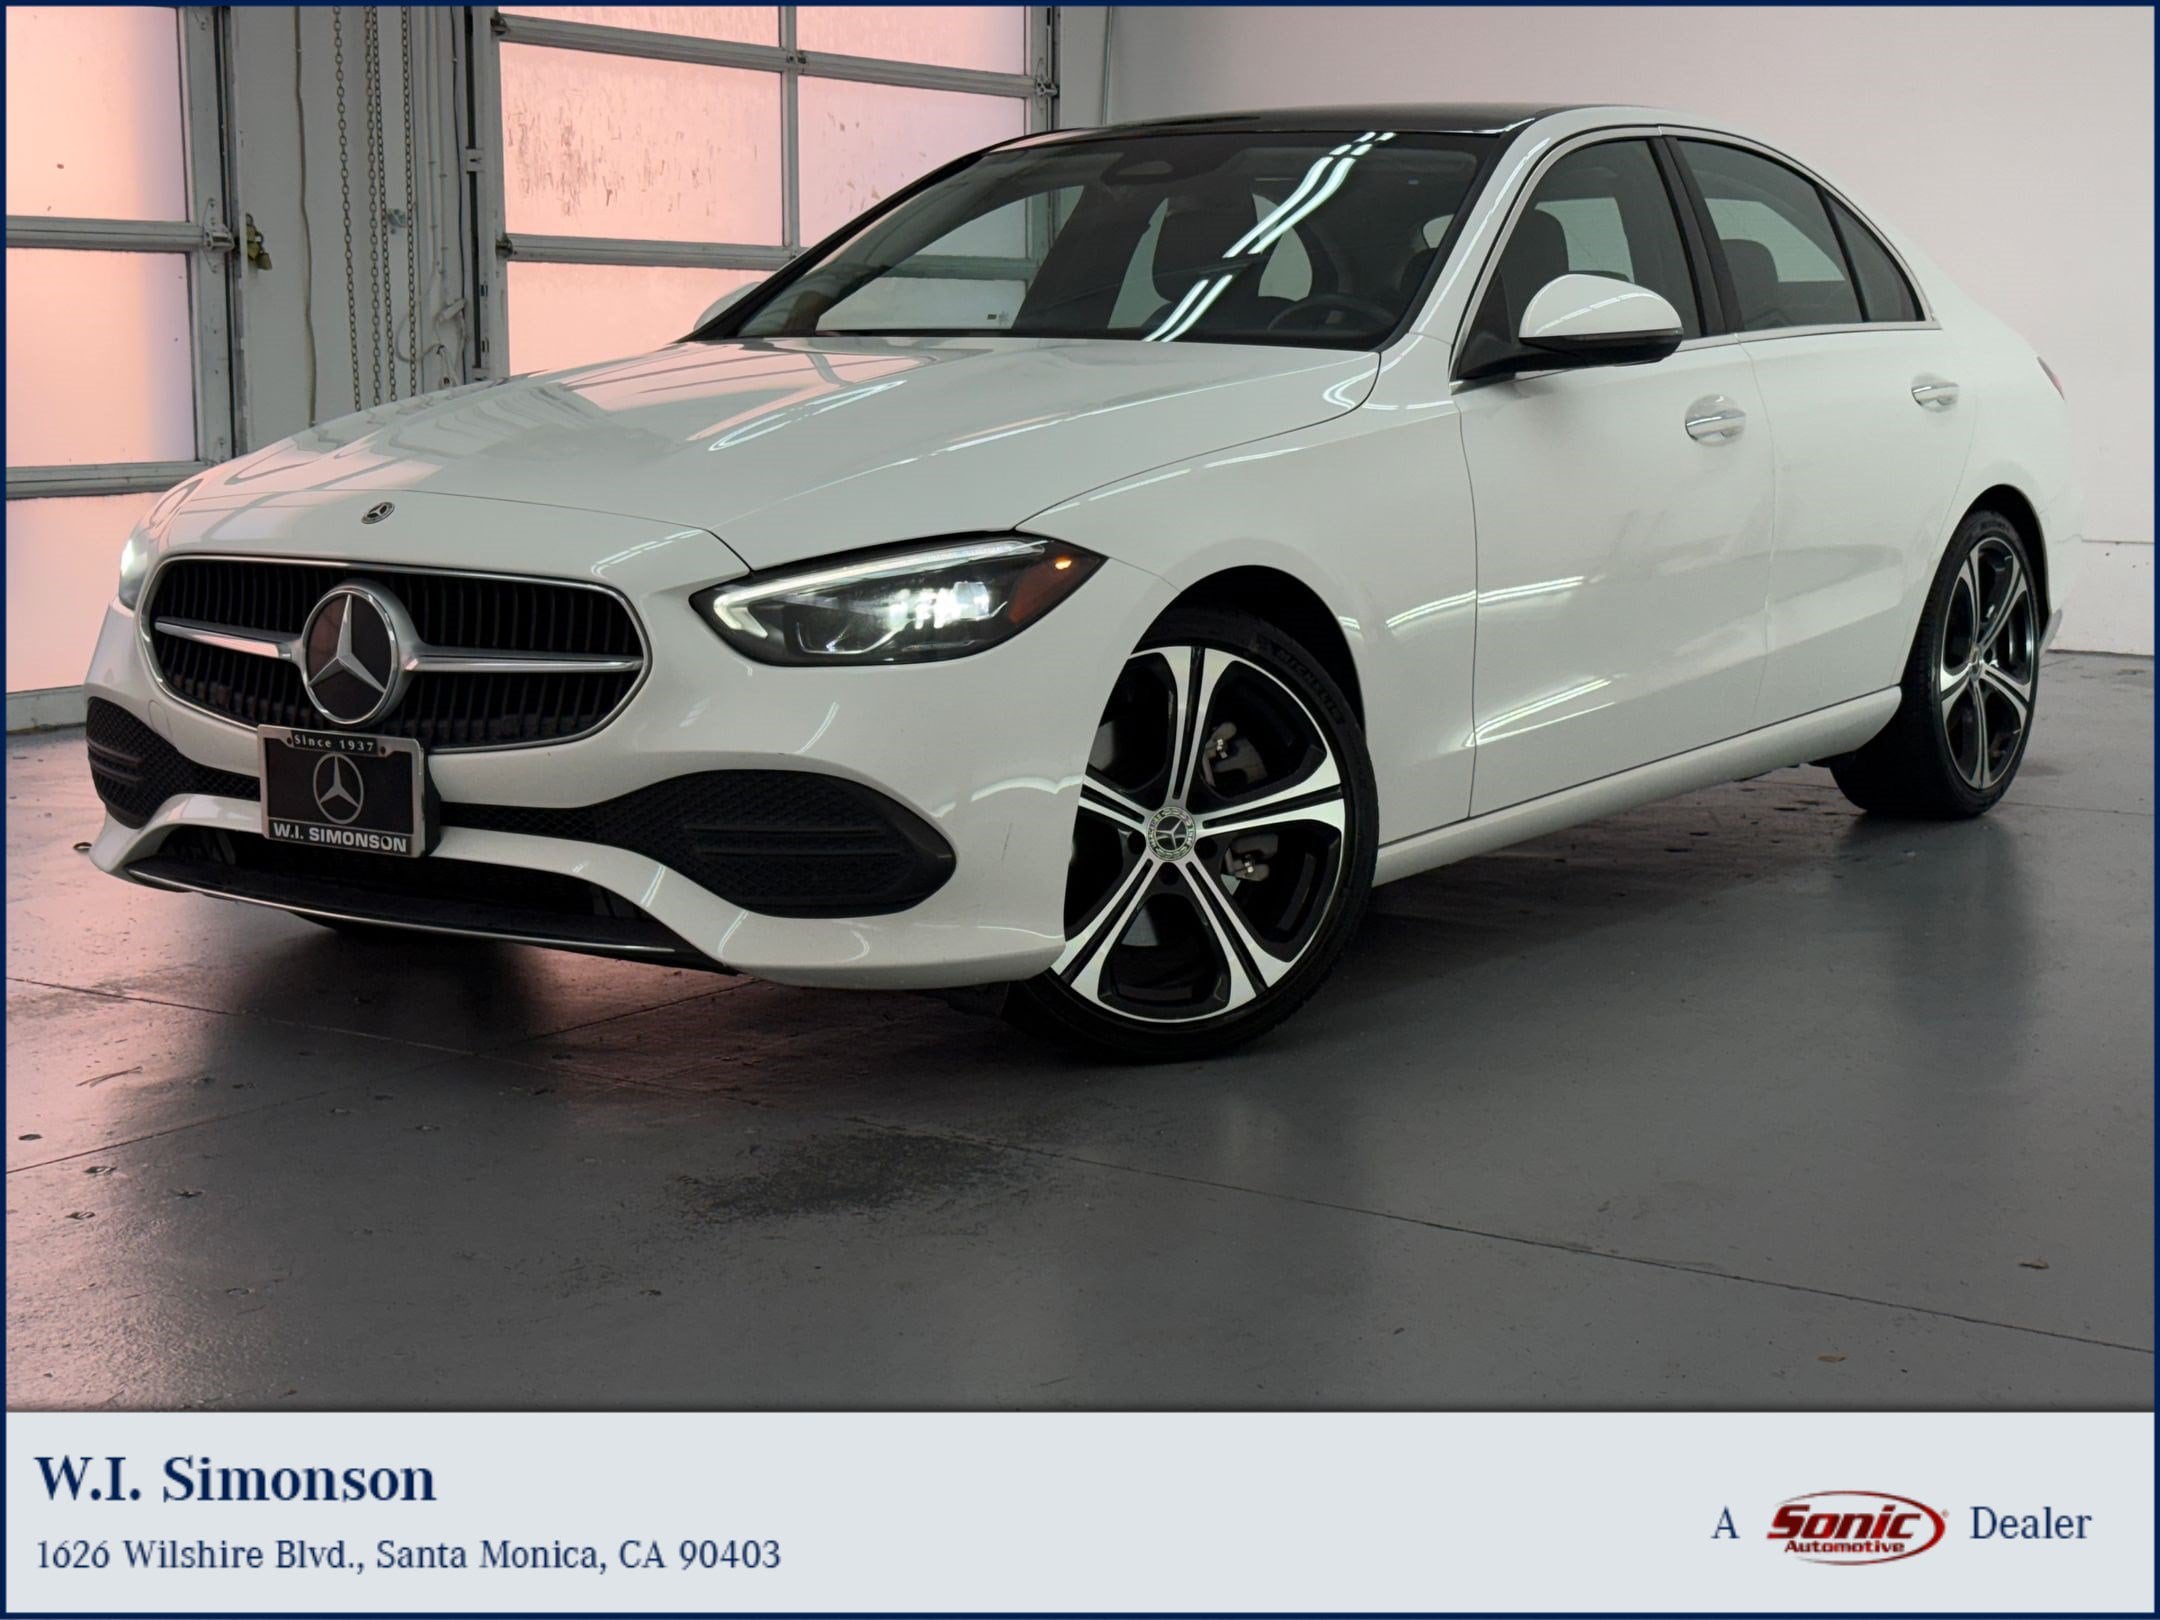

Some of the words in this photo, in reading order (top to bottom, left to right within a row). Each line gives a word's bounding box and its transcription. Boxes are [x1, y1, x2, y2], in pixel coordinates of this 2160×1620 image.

[294, 734, 332, 749] Since
[340, 739, 375, 753] 1937
[273, 822, 304, 840] W.I.
[309, 828, 407, 853] SIMONSON
